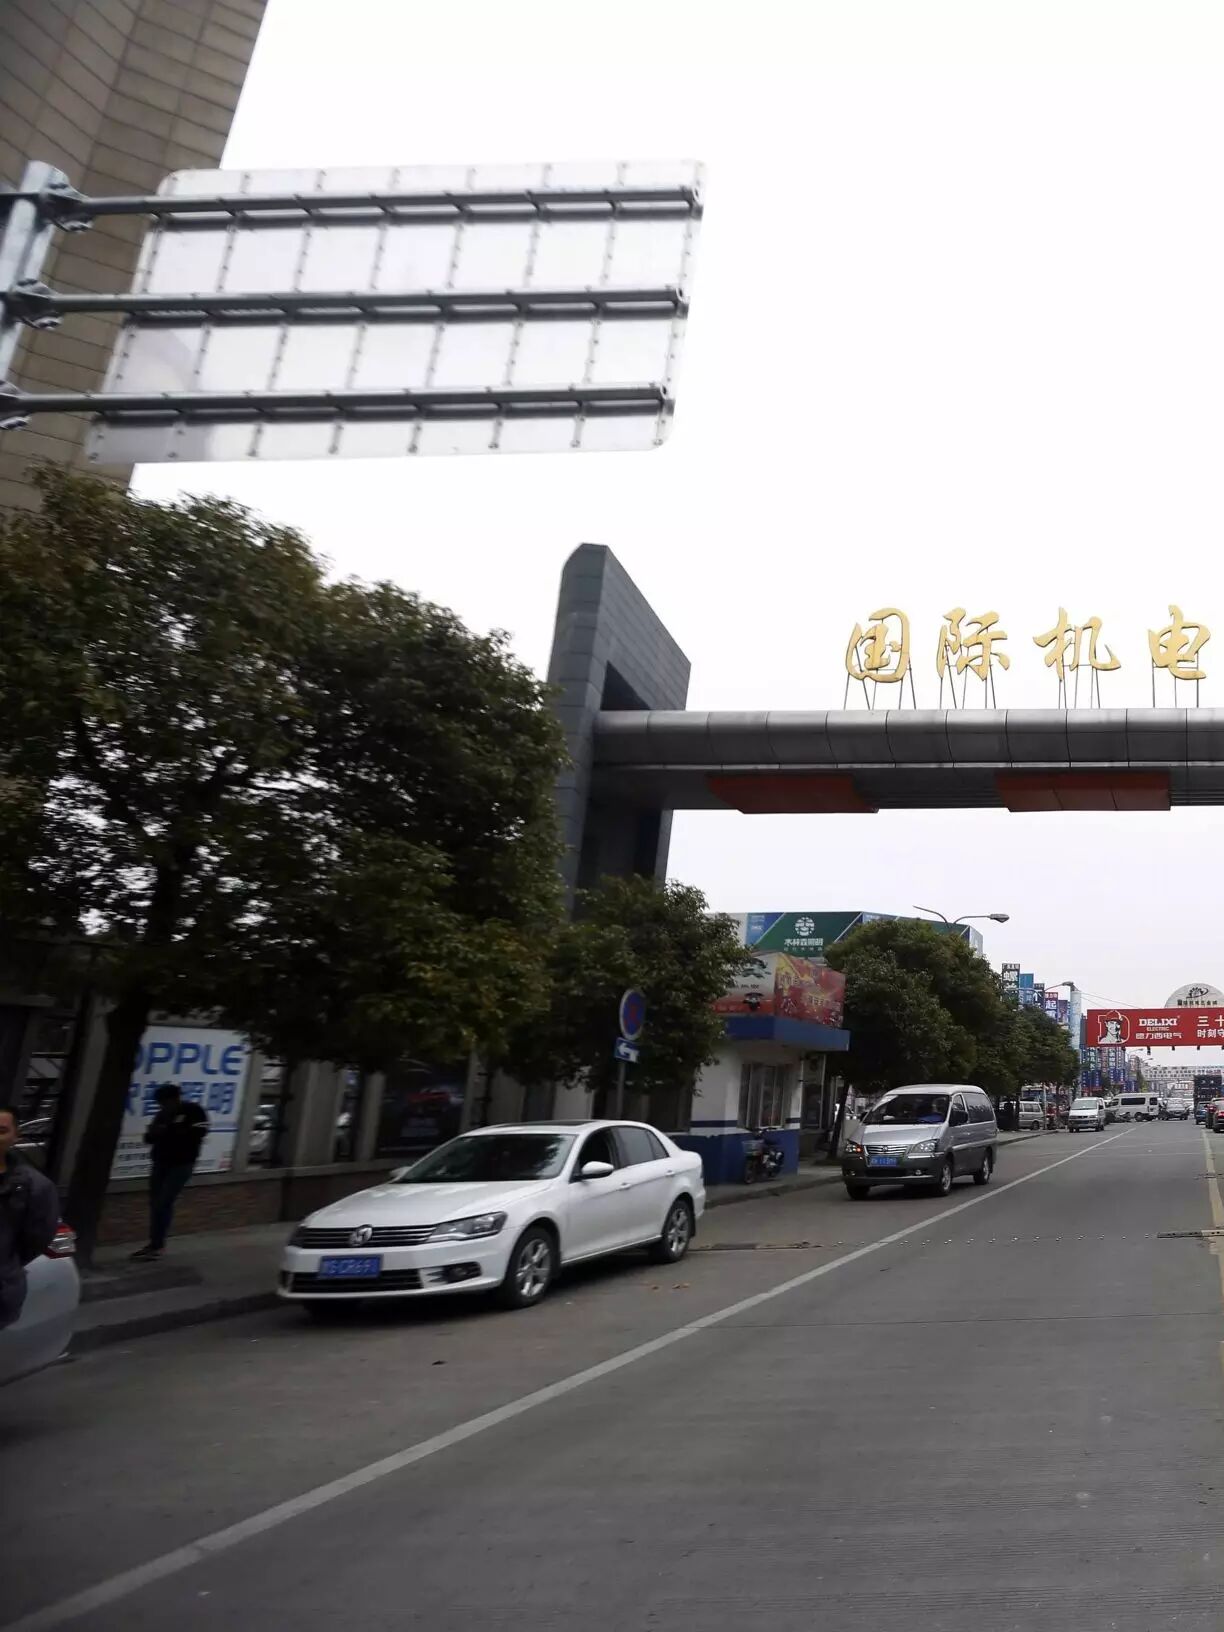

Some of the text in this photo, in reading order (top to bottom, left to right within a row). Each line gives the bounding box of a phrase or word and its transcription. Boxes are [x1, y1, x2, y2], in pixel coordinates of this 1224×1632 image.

[784, 938, 824, 947] 木林森照明
[1139, 1018, 1178, 1027] DELIXI
[1135, 1032, 1183, 1040] 德力西电气
